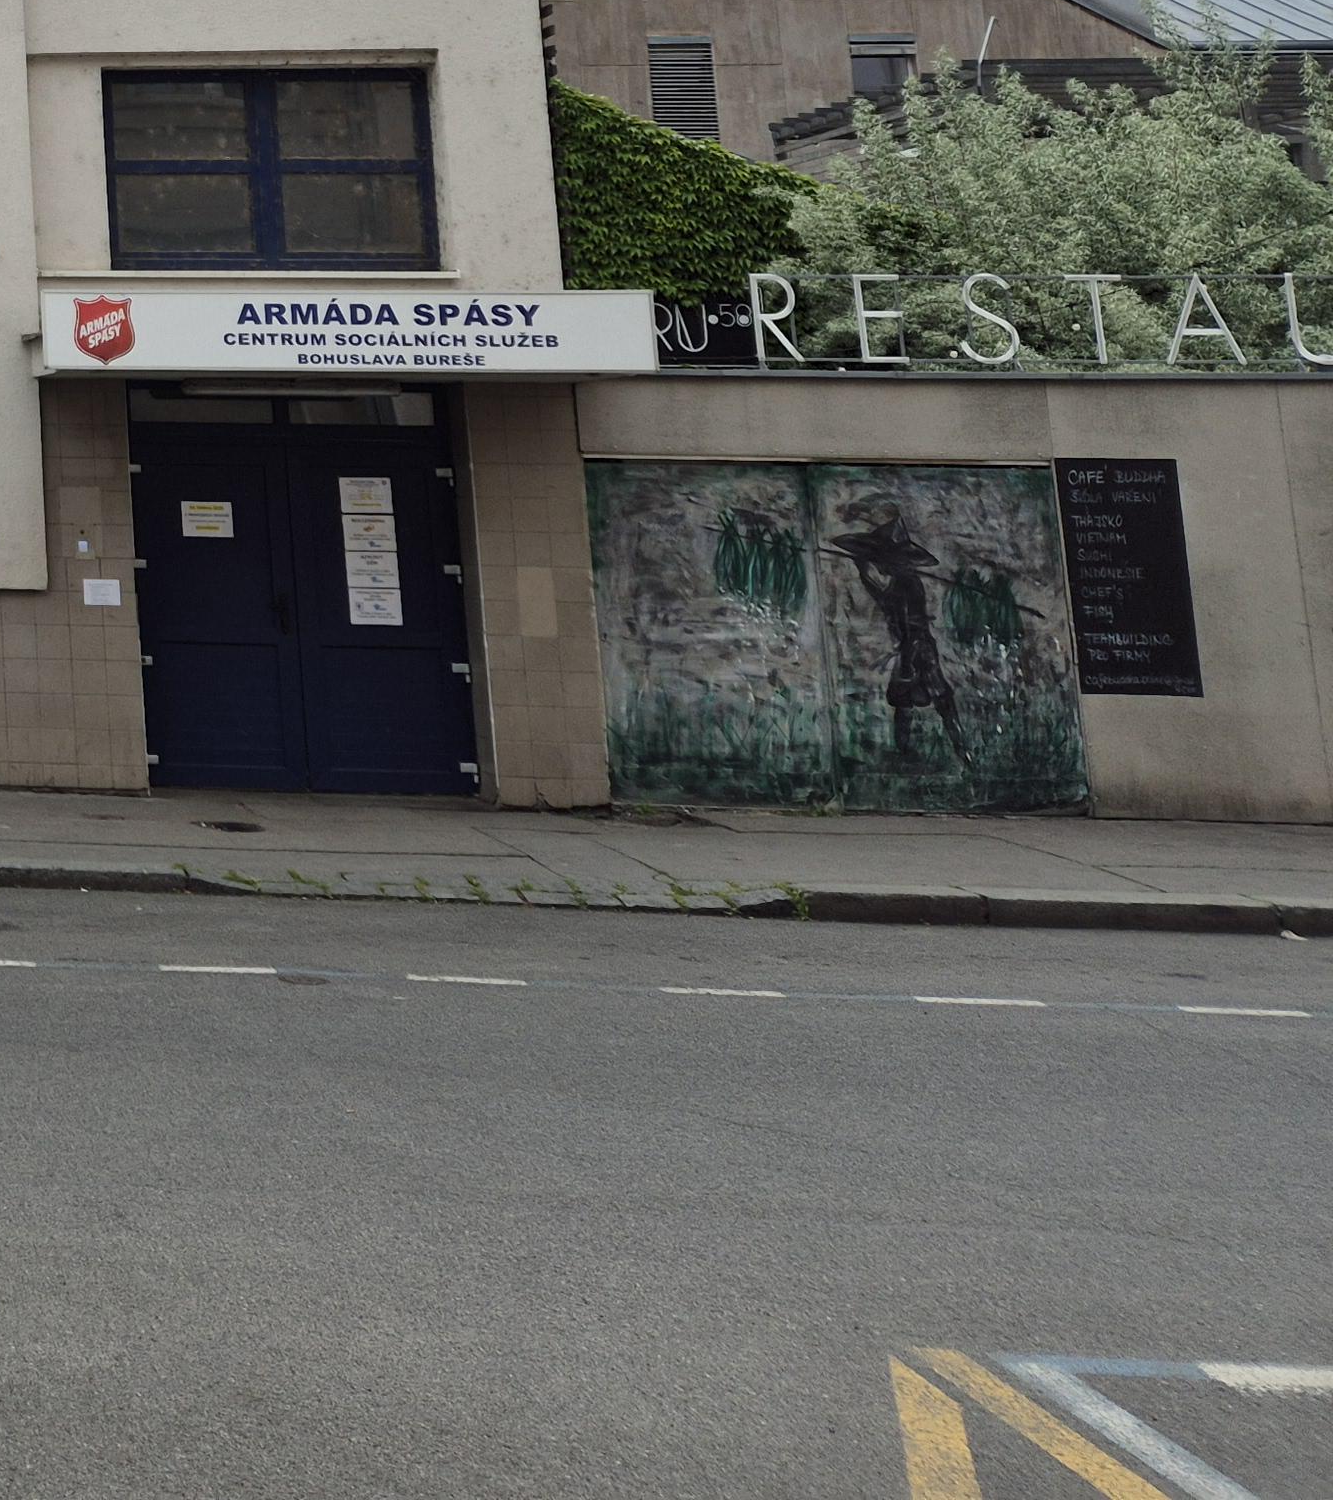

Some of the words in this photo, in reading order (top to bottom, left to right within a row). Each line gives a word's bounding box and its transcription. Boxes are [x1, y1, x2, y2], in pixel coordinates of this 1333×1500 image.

[237, 298, 400, 325] ARMÁDA
[413, 299, 541, 326] SPÁSY
[80, 308, 125, 339] ARMÁDA
[89, 323, 121, 348] SPÁSY
[223, 332, 326, 346] CENTRUM
[335, 331, 467, 348] SOCIÁLNÍCH
[475, 332, 559, 348] SLUŽEB
[297, 353, 407, 365] BOHUSLAVA
[413, 353, 486, 367] BUREŠE
[1076, 533, 1127, 545] VIETNAM
